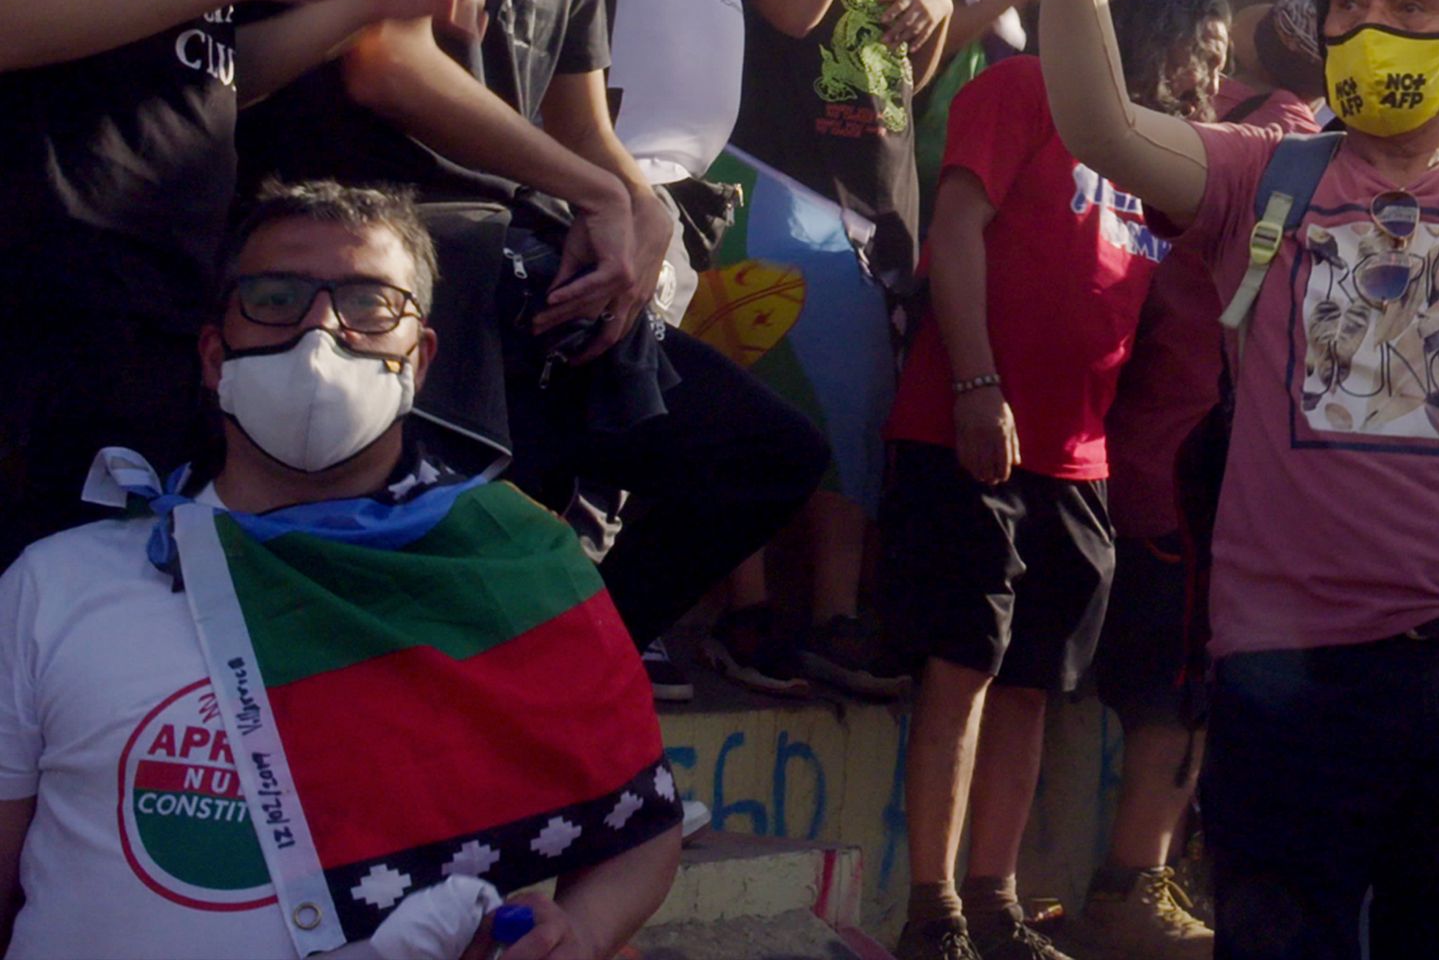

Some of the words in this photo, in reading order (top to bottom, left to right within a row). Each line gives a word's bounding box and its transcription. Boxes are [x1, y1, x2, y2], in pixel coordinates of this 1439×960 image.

[175, 29, 236, 92] CLU
[1380, 91, 1424, 109] AFP
[148, 724, 235, 765] APR
[184, 768, 242, 796] NU
[138, 793, 248, 822] CONSTIT
